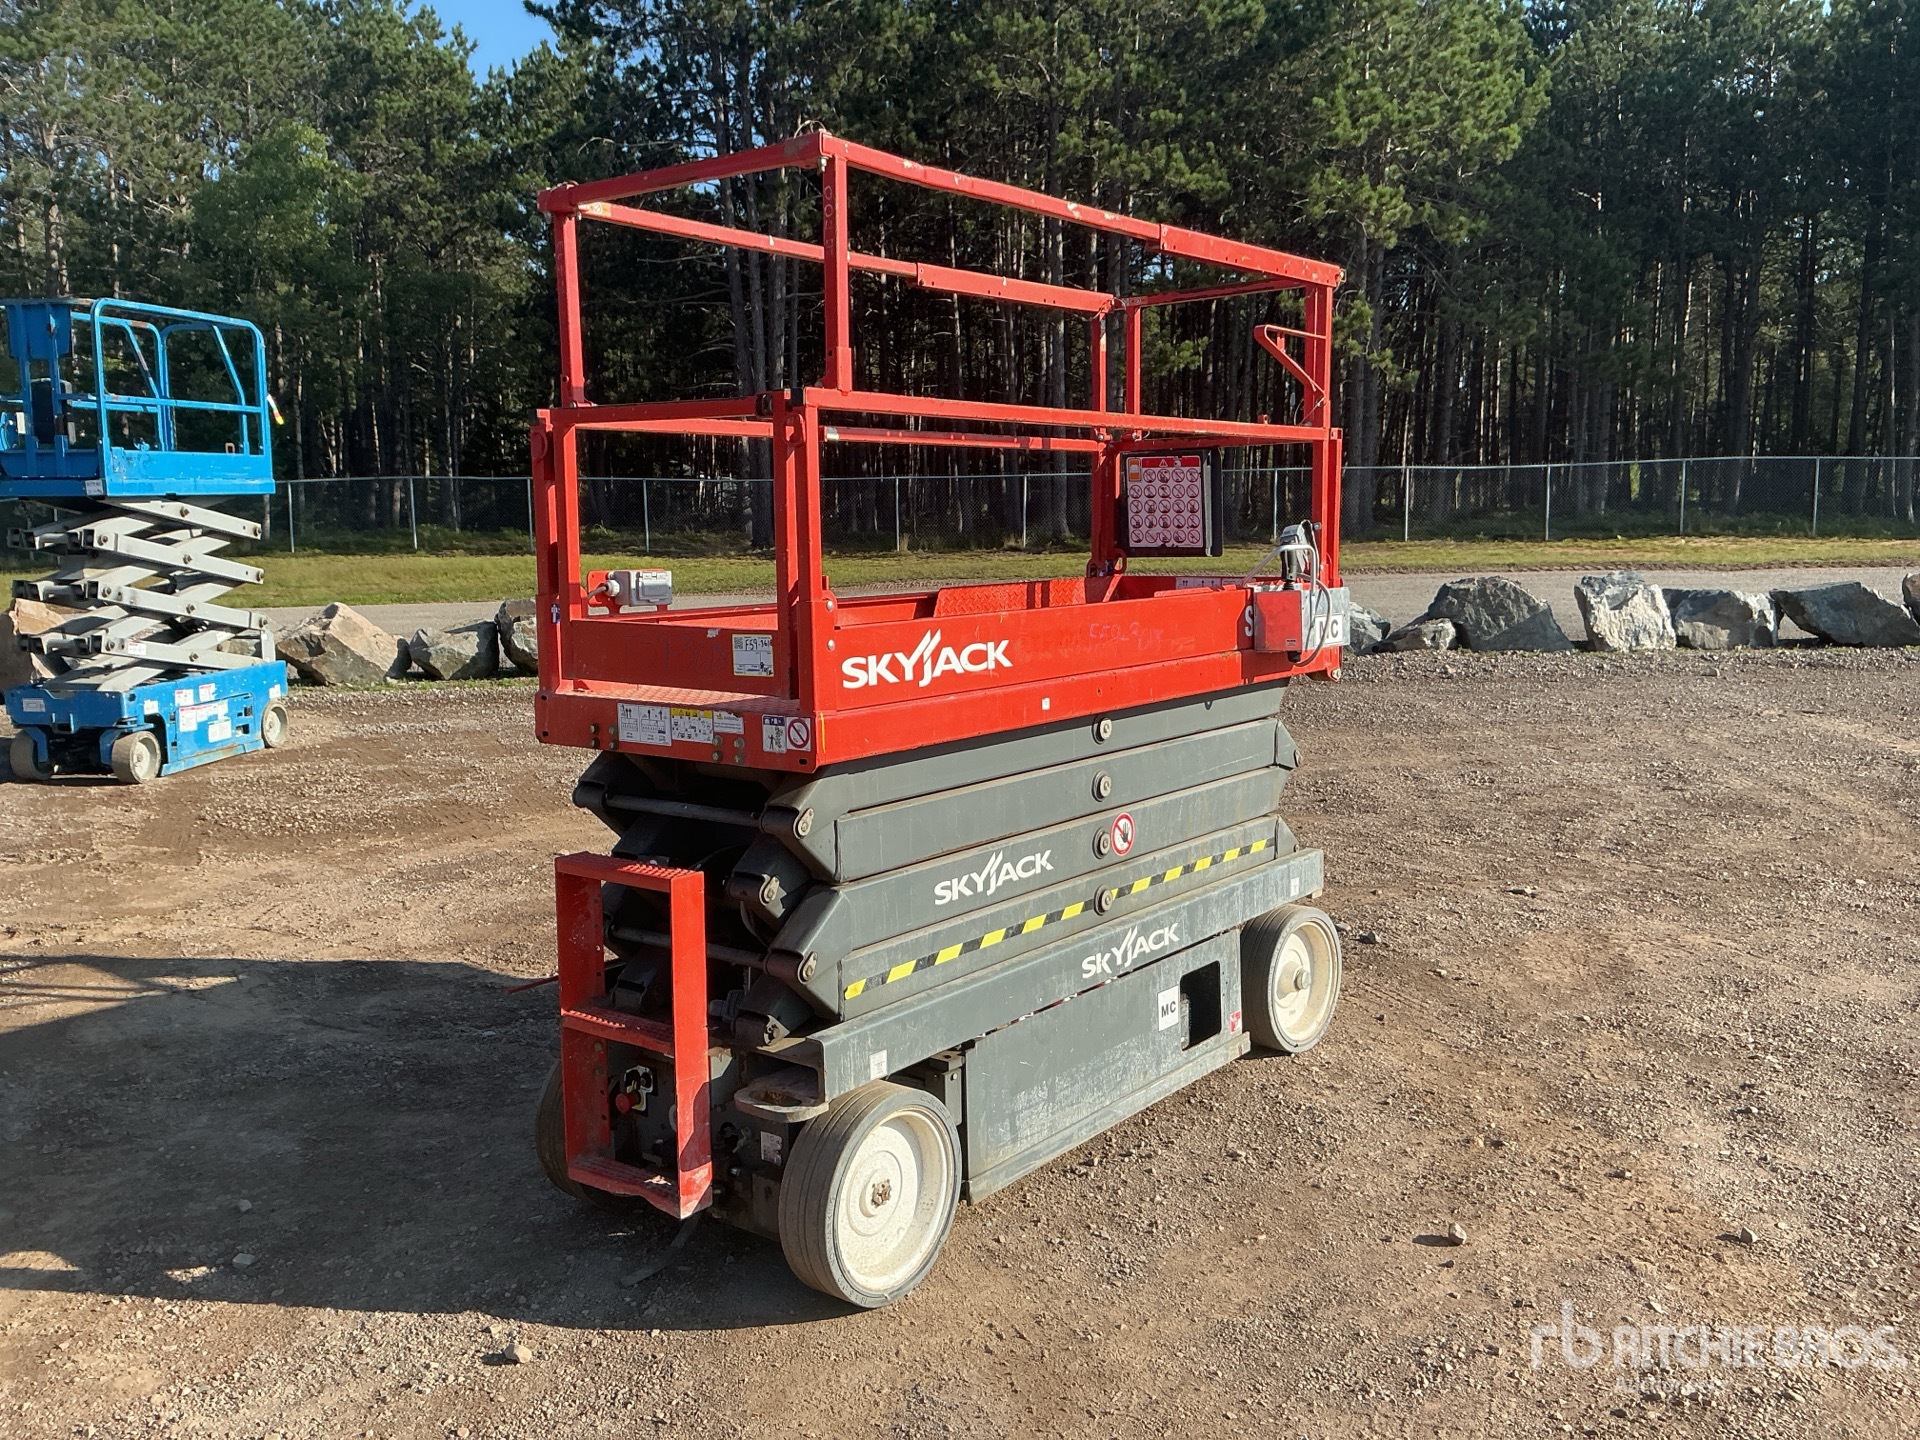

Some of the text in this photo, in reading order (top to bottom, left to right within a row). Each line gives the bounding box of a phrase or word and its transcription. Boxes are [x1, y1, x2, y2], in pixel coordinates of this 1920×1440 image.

[841, 628, 1013, 689] SKYJACK
[934, 849, 1054, 905] SKYJACK
[1082, 922, 1180, 979] SKYJACK
[1161, 1000, 1177, 1018] MC
